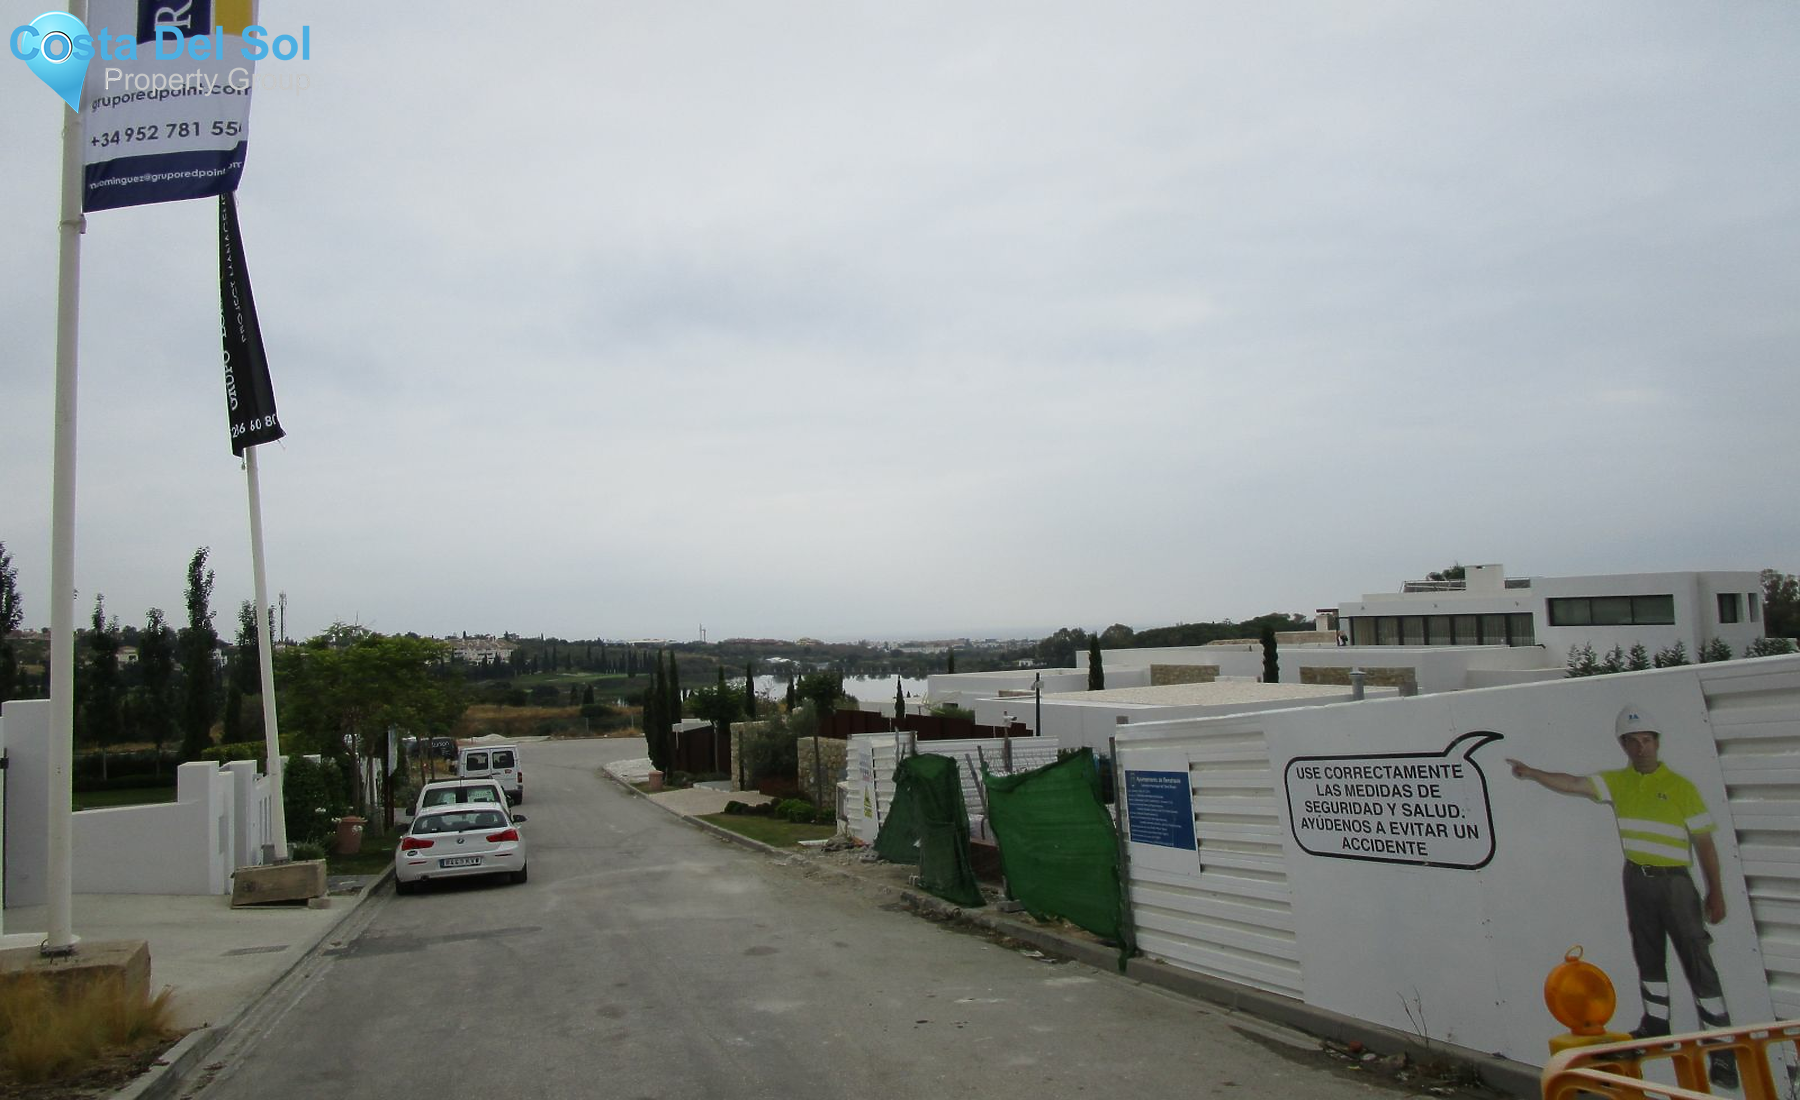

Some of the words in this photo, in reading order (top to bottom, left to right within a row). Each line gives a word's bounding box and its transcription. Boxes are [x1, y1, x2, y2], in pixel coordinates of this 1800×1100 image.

[91, 130, 121, 147] +34
[124, 125, 159, 142] 952
[165, 121, 200, 139] 781
[1296, 766, 1322, 780] USE
[1324, 763, 1464, 780] CORRECTAMENTE
[1316, 783, 1342, 797] LAS
[1344, 783, 1413, 798] MEDIDAS
[1417, 784, 1442, 799] DE
[1304, 800, 1384, 816] SEGURIDAD
[1386, 803, 1397, 816] Y
[1301, 814, 1372, 834] AYÚDENOS
[1375, 820, 1387, 835] A
[1389, 821, 1449, 839] EVITAR
[1453, 824, 1479, 840] UN
[1341, 836, 1429, 856] ACCIDENTE
